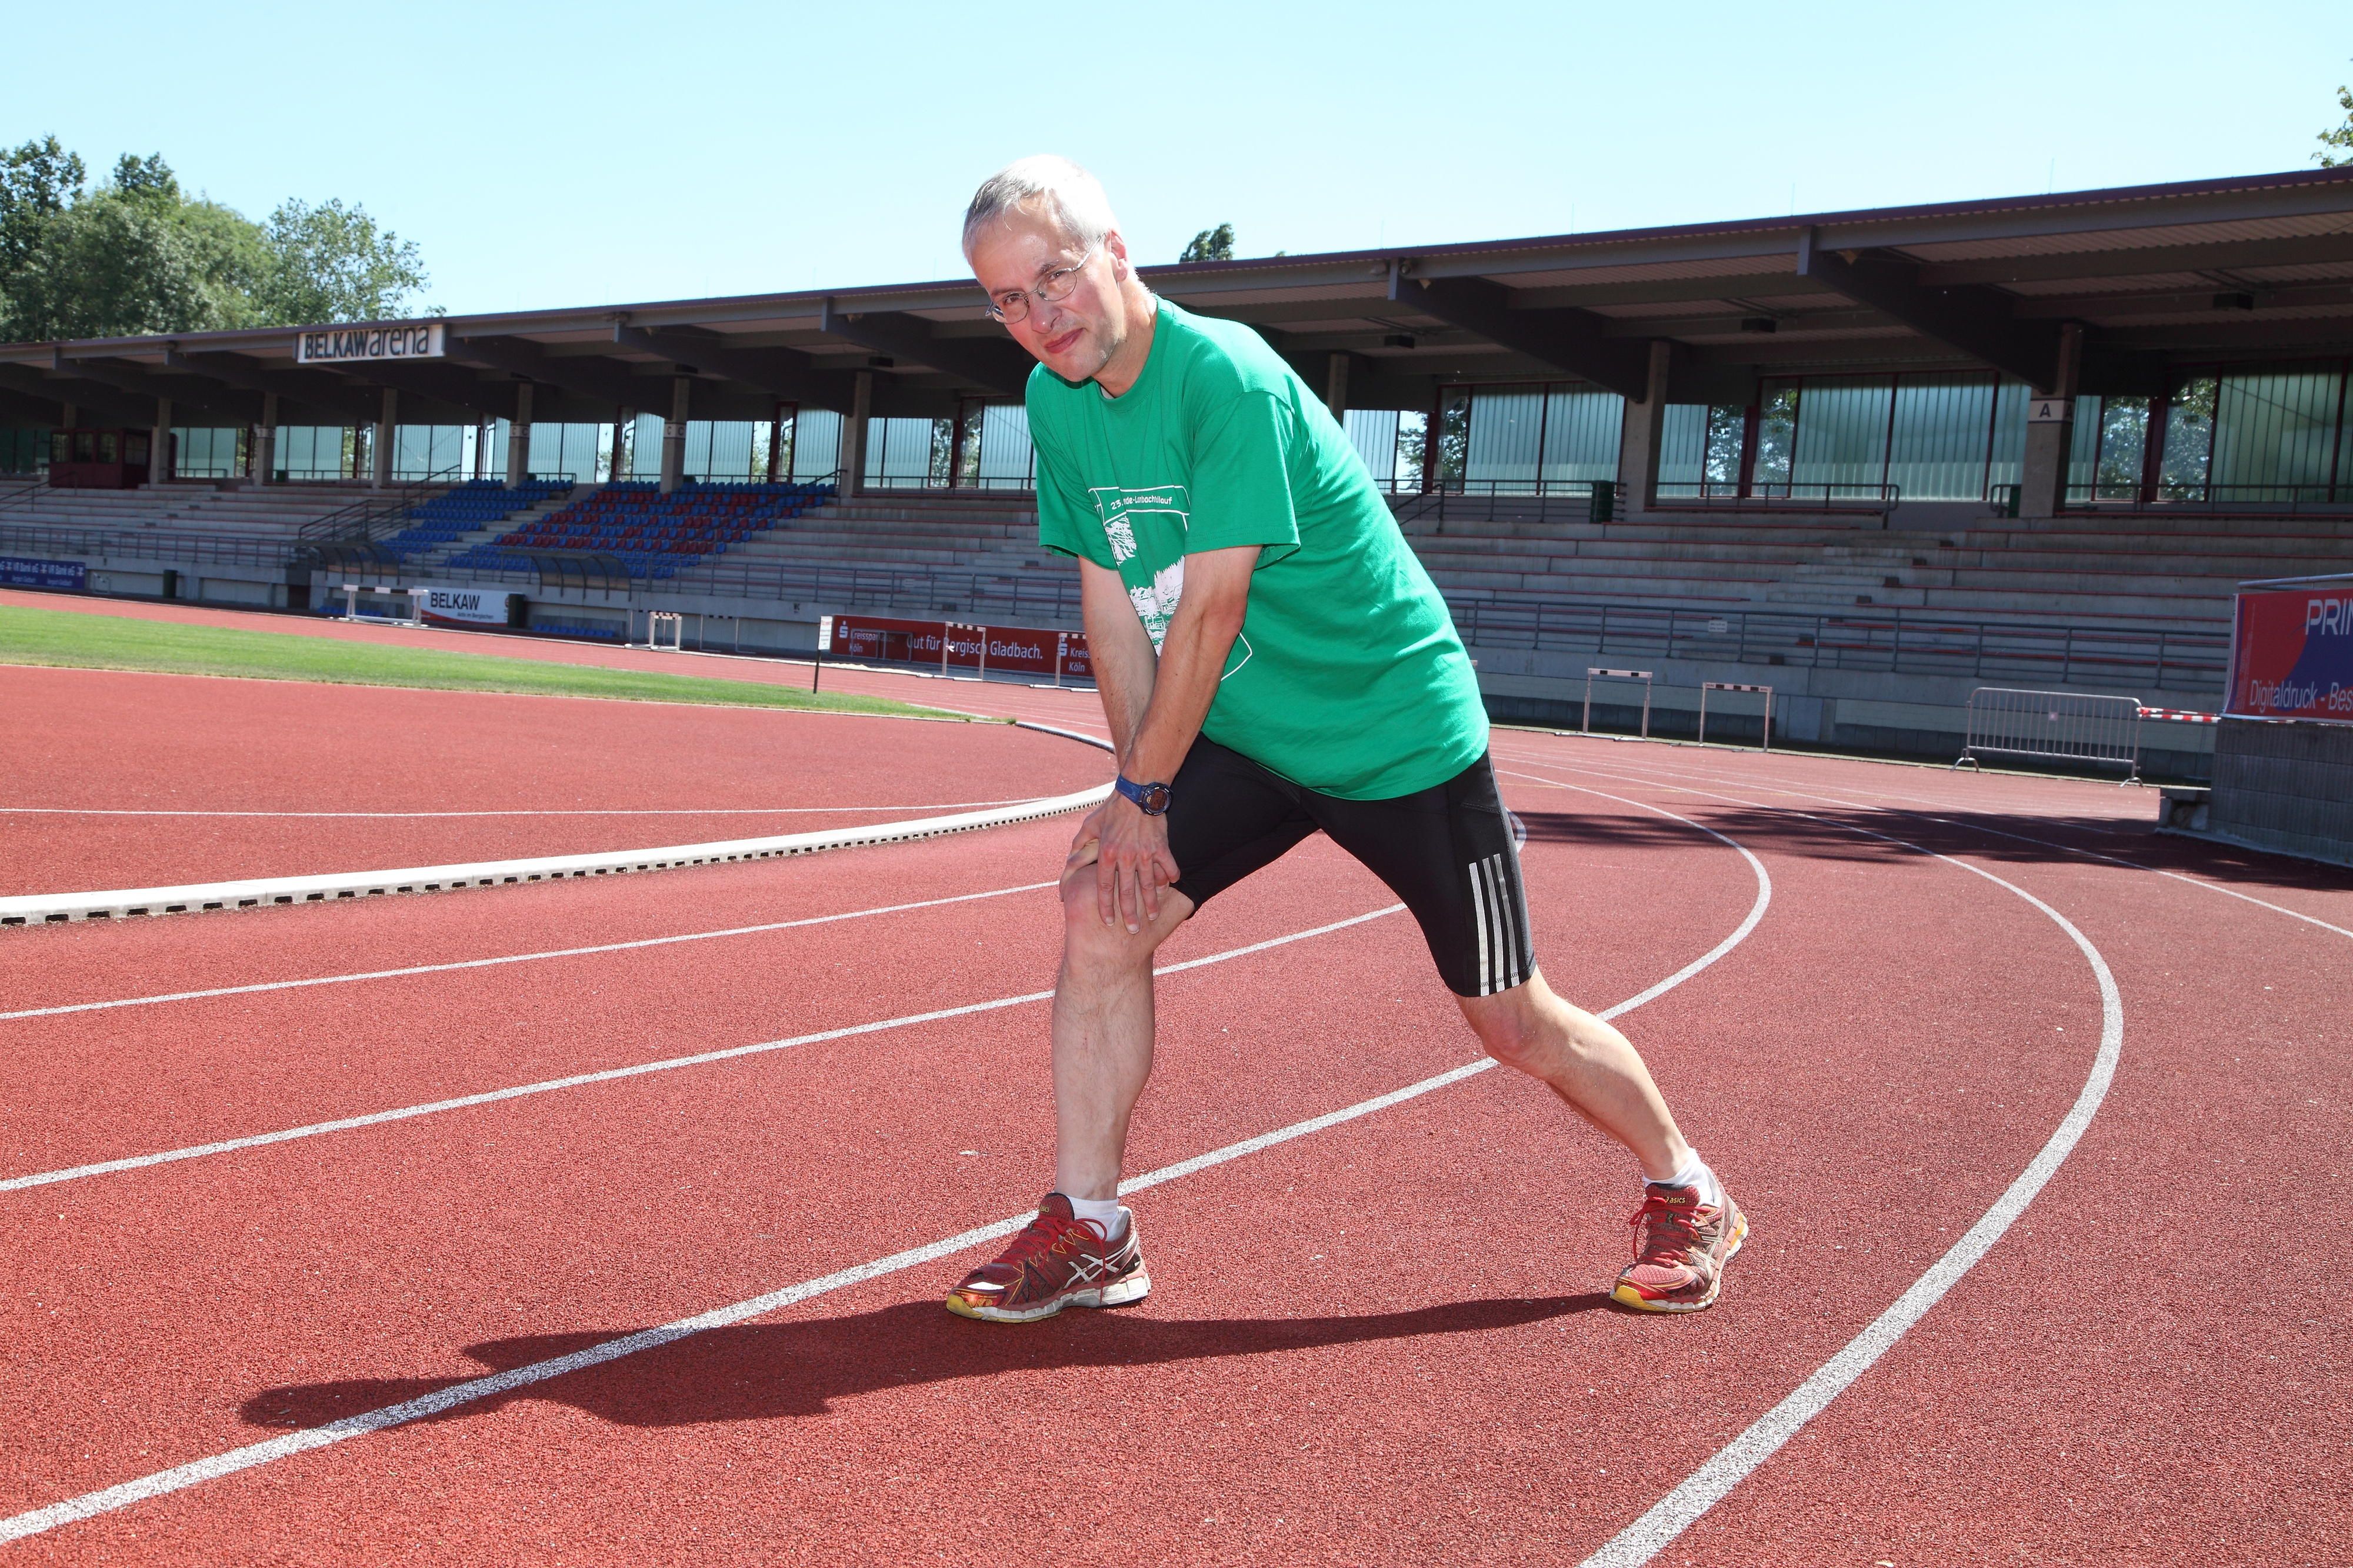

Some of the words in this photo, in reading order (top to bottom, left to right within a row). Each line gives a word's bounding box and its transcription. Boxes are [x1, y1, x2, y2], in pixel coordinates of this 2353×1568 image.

[2039, 402, 2051, 418] A
[678, 426, 685, 435] C
[1110, 499, 1124, 510] 23.
[431, 592, 480, 610] BELKAW
[926, 635, 941, 650] für
[990, 640, 1043, 659] Gladbach.
[1069, 661, 1085, 672] Köln
[2249, 680, 2318, 713] Digitaldruck
